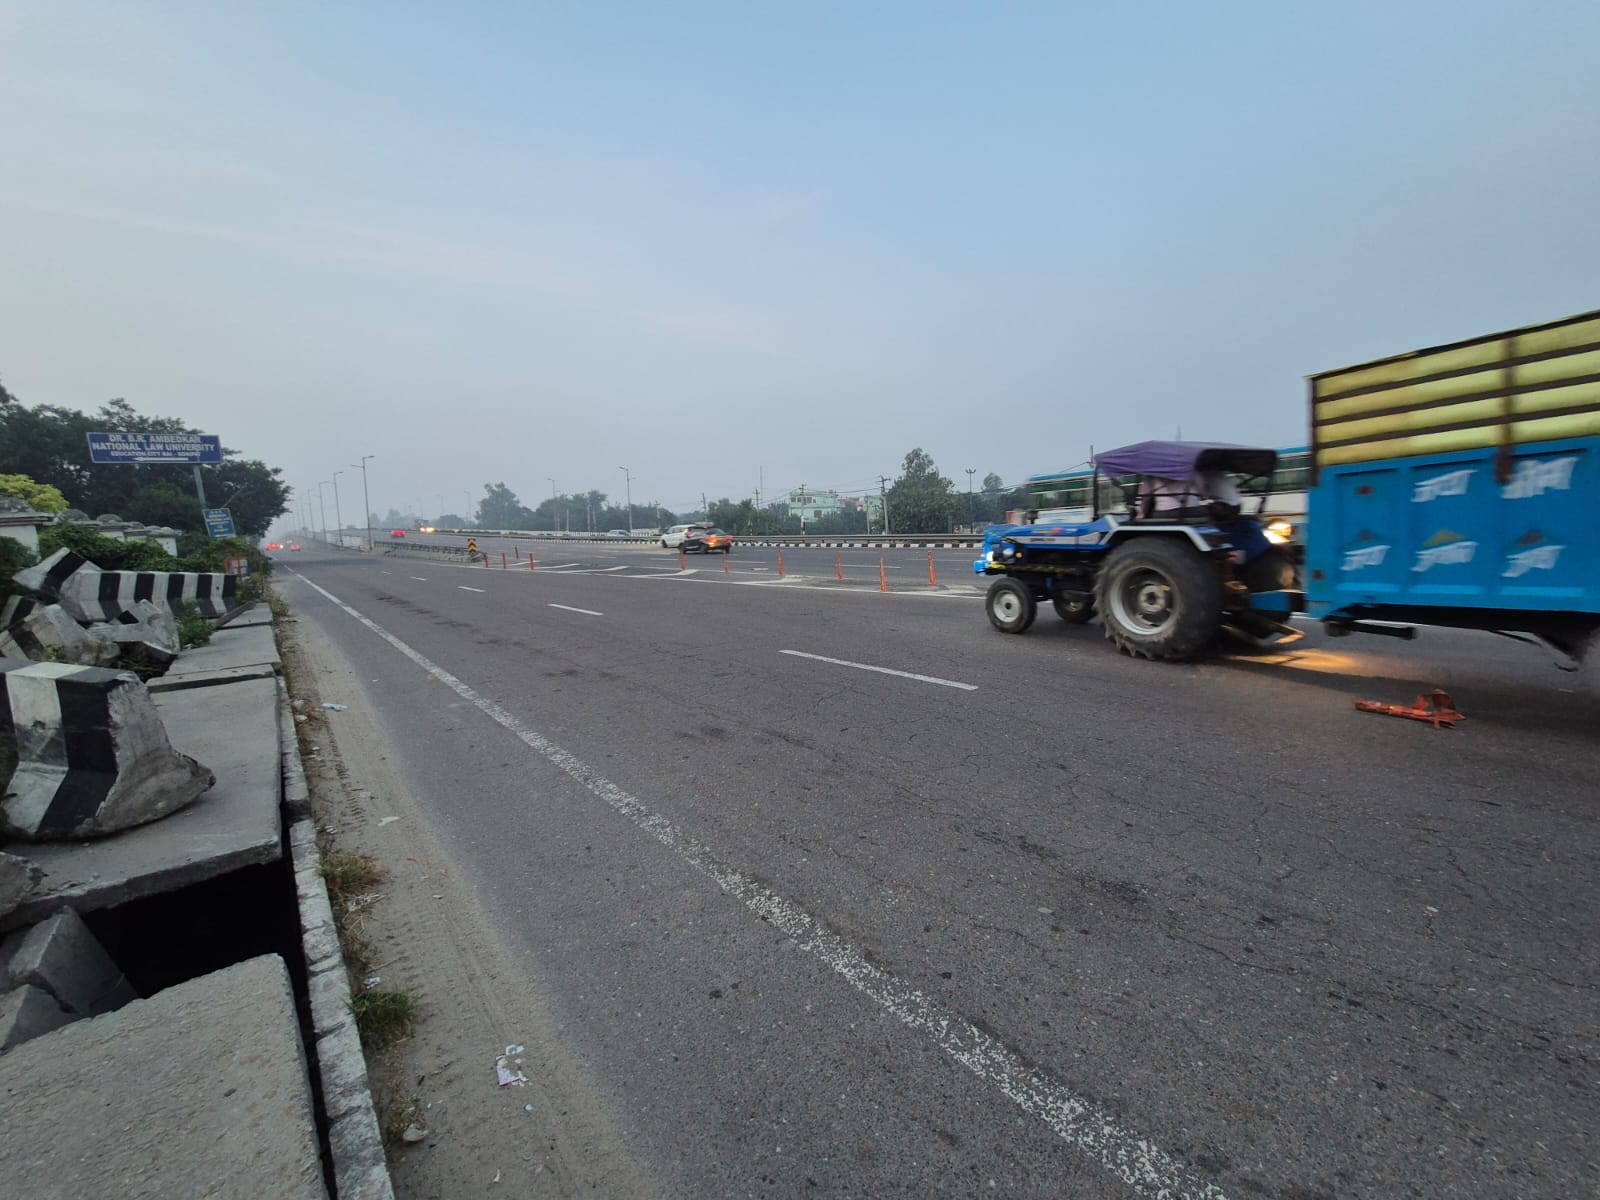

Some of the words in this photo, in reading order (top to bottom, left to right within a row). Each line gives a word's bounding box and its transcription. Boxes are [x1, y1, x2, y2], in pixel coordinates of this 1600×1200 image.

[149, 435, 201, 443] AMBEDKAR
[92, 442, 141, 450] NATIONAL
[144, 443, 163, 451] LAW
[165, 443, 215, 452] UNIVERSITY
